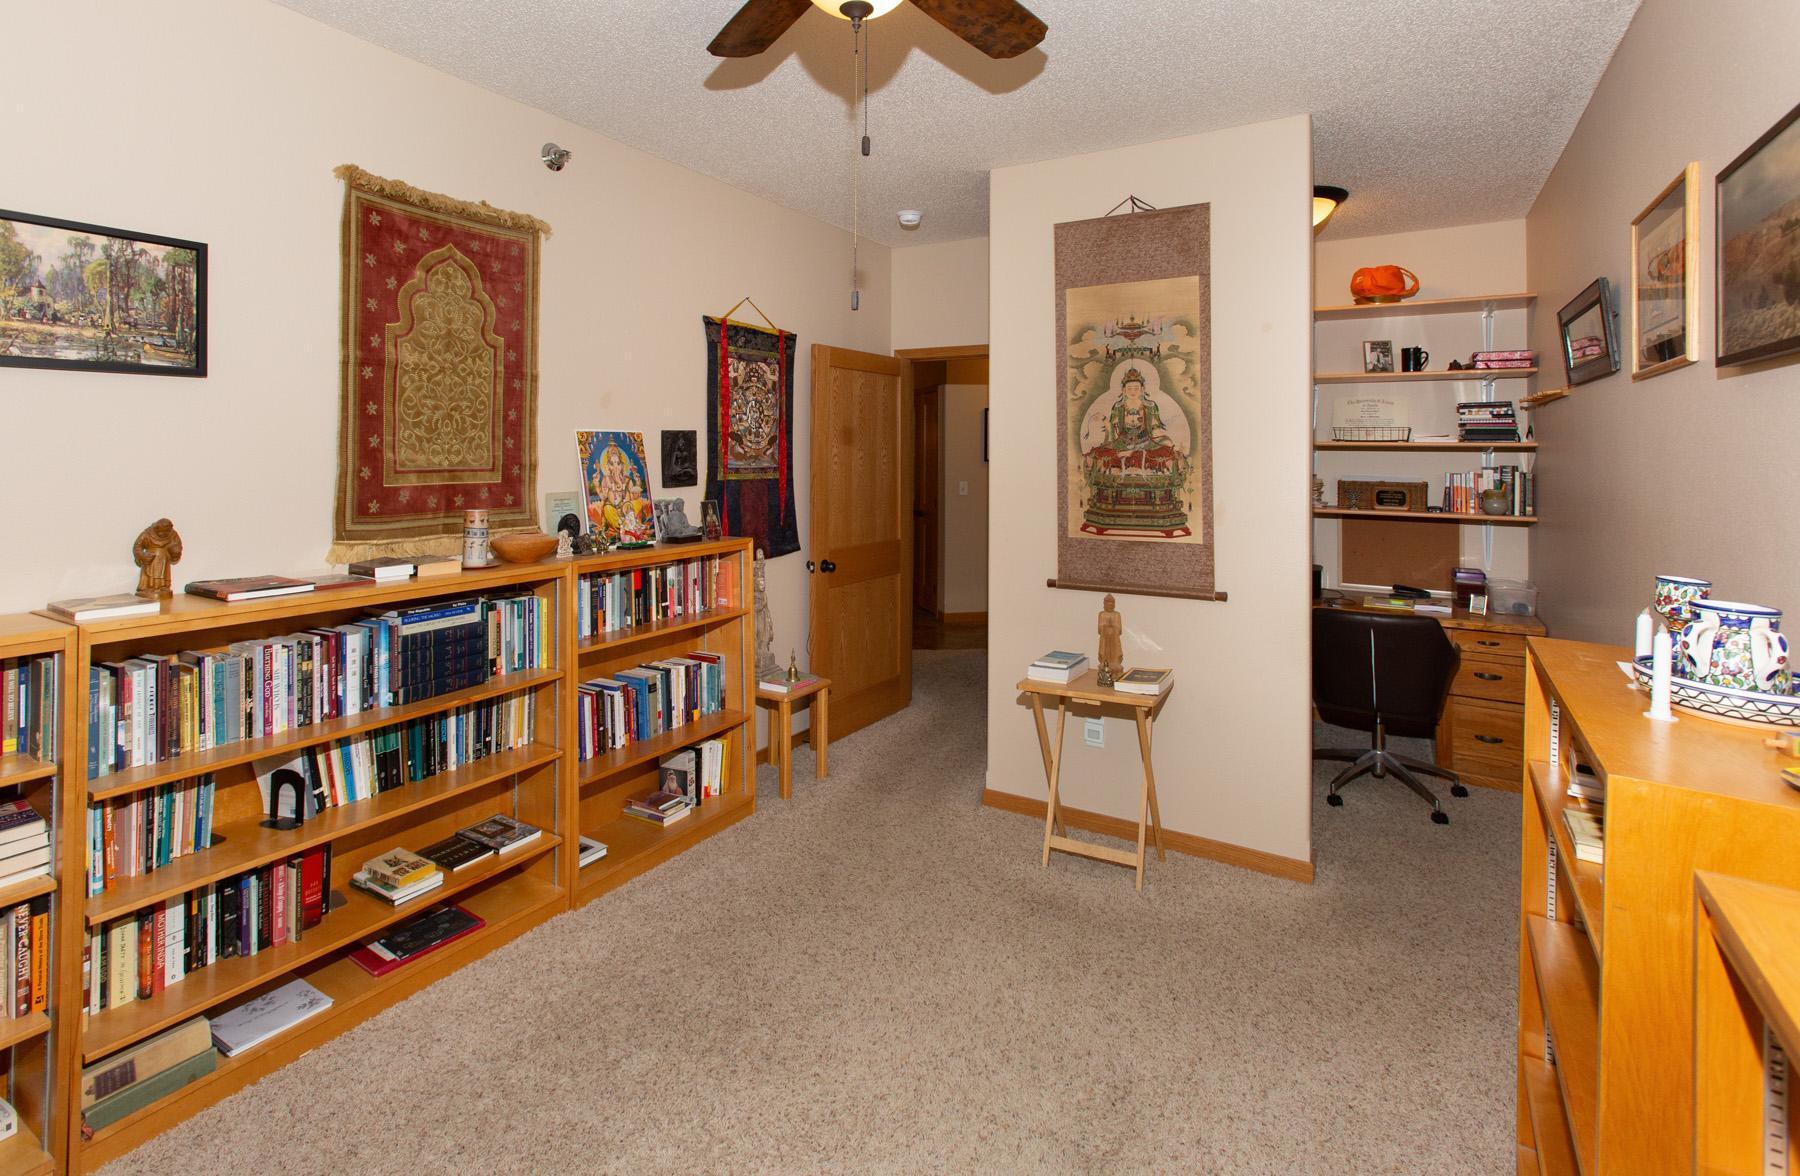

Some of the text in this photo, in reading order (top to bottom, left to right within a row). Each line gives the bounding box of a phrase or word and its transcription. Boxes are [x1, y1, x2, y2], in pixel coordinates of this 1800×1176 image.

[264, 648, 272, 680] BIRTHING
[18, 904, 29, 981] NEVER CAUGHT
[157, 914, 166, 970] MOTHER INDIA
